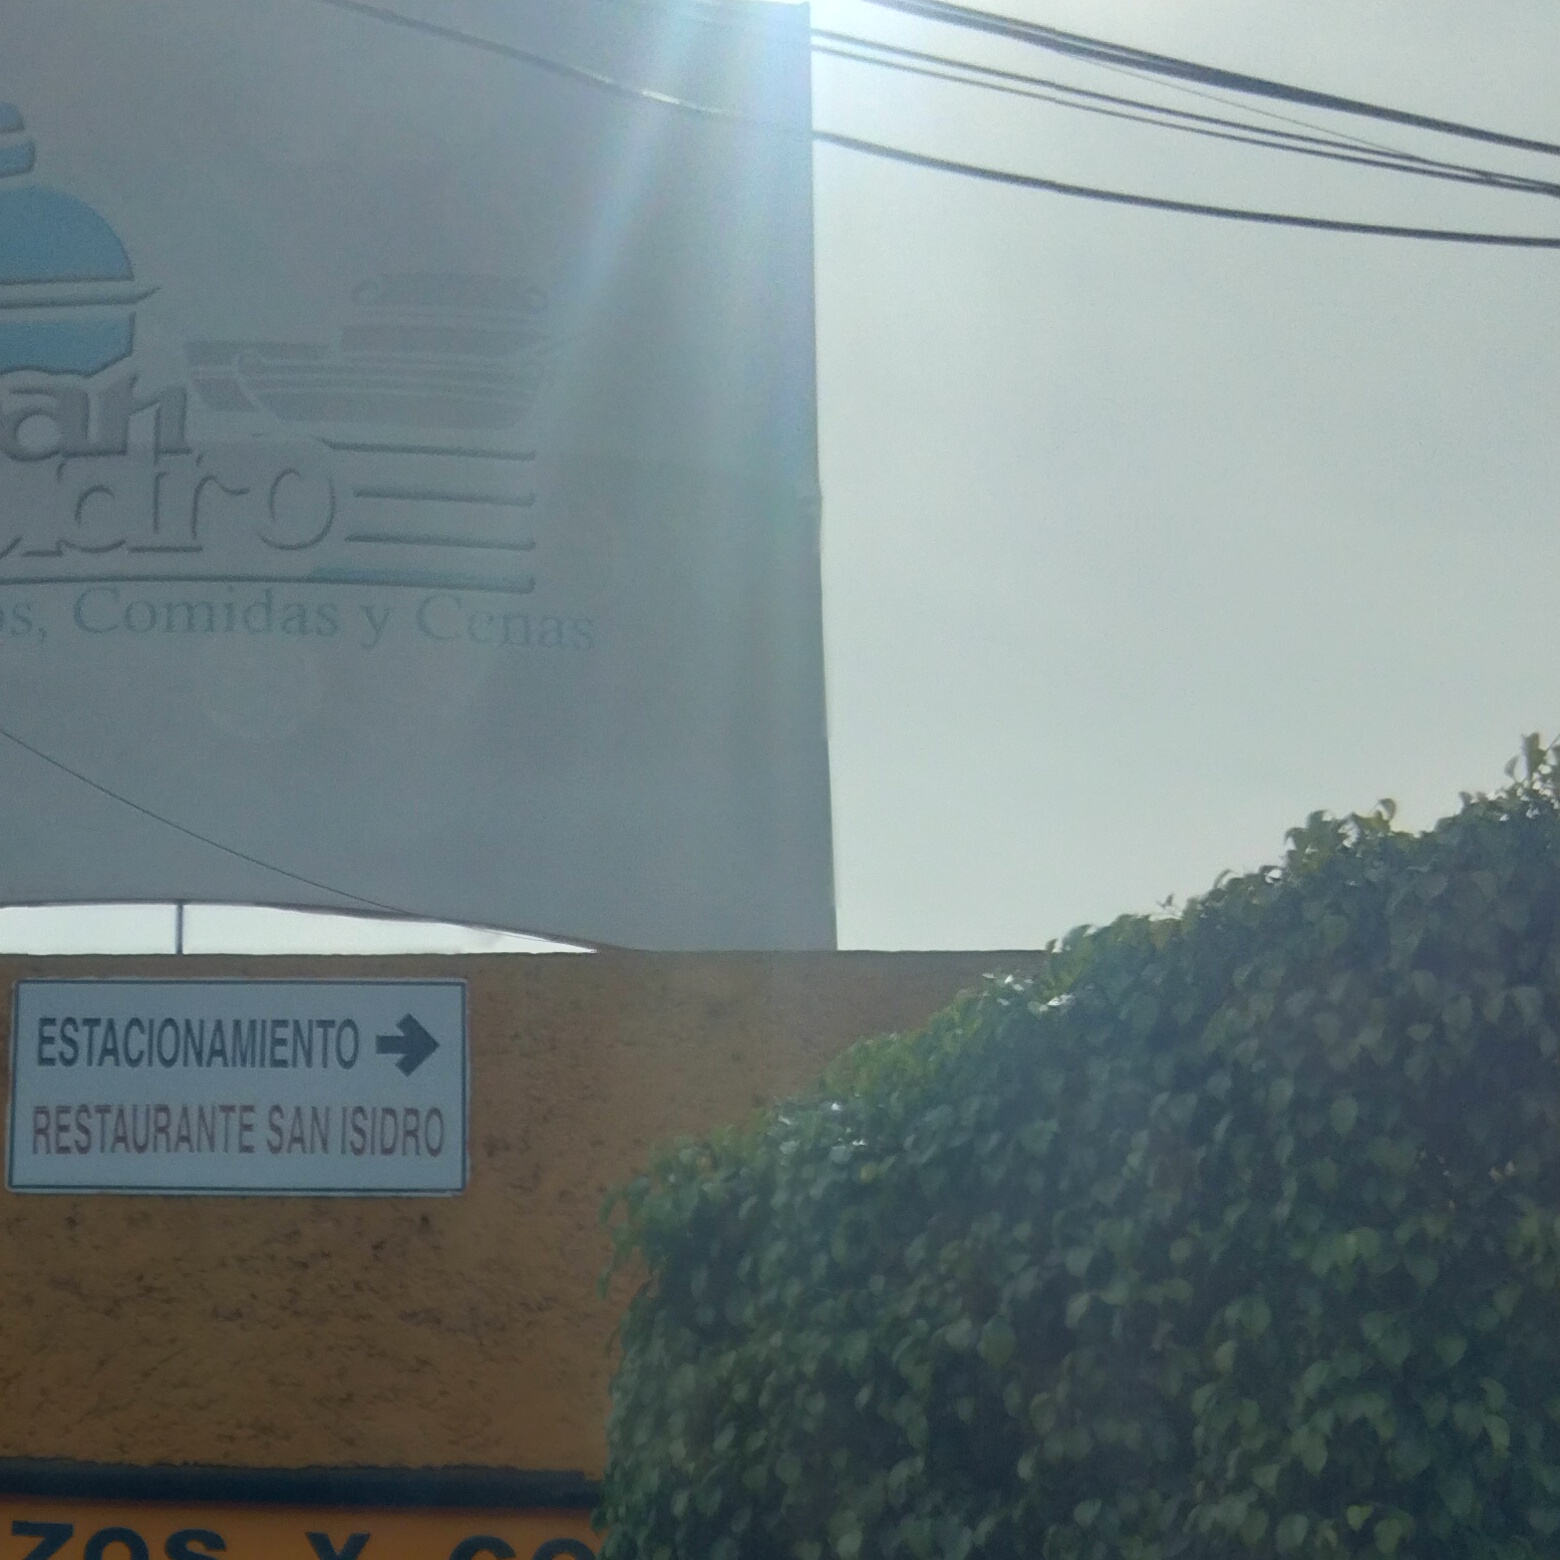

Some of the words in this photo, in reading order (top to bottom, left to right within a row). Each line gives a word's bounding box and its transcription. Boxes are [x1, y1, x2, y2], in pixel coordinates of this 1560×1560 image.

[73, 585, 340, 639] Comidas
[360, 602, 393, 647] y
[414, 592, 598, 652] Cenas
[37, 1016, 361, 1070] ESTACIONAMIENTO
[31, 1104, 256, 1156] RESTAURANTE
[266, 1105, 331, 1156] SAN
[339, 1105, 446, 1158] ISIDRO
